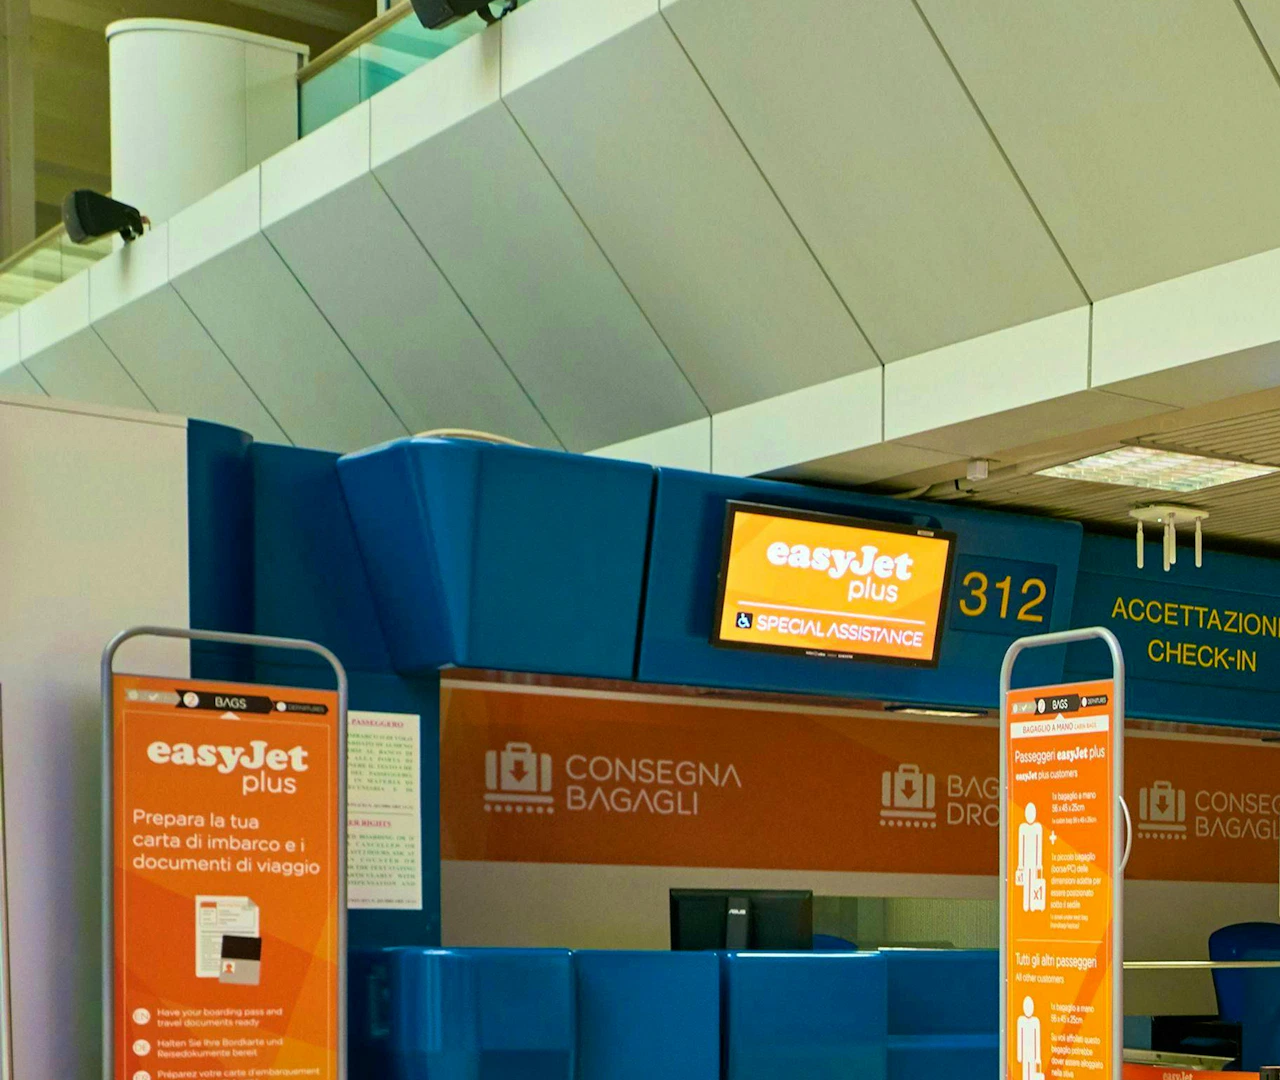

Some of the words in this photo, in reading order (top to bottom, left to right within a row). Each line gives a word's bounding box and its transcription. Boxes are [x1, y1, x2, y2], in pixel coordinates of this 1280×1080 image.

[767, 541, 914, 581] easyJet
[847, 577, 898, 602] plus
[959, 570, 1047, 622] 312
[757, 614, 824, 636] SPECIAL
[826, 621, 923, 647] ASSISTANCE
[1148, 641, 1256, 672] CHECK-IN
[215, 697, 246, 709] BAGS
[1052, 698, 1068, 710] BAGS
[147, 740, 308, 773] easyJet
[242, 771, 296, 794] plus
[565, 755, 741, 788] CONSEGNA
[566, 786, 698, 815] BAGAGLI
[133, 810, 204, 829] Prepara
[210, 813, 225, 828] la
[231, 816, 259, 829] tua
[948, 802, 999, 826] DRO
[1195, 816, 1280, 840] BAGAGL
[132, 836, 180, 848] carta
[186, 834, 202, 848] di
[208, 836, 280, 851] imbarco
[286, 840, 295, 852] e
[301, 838, 305, 852] i
[133, 855, 230, 871] documenti
[237, 858, 252, 872] di
[257, 860, 320, 876] viaggio
